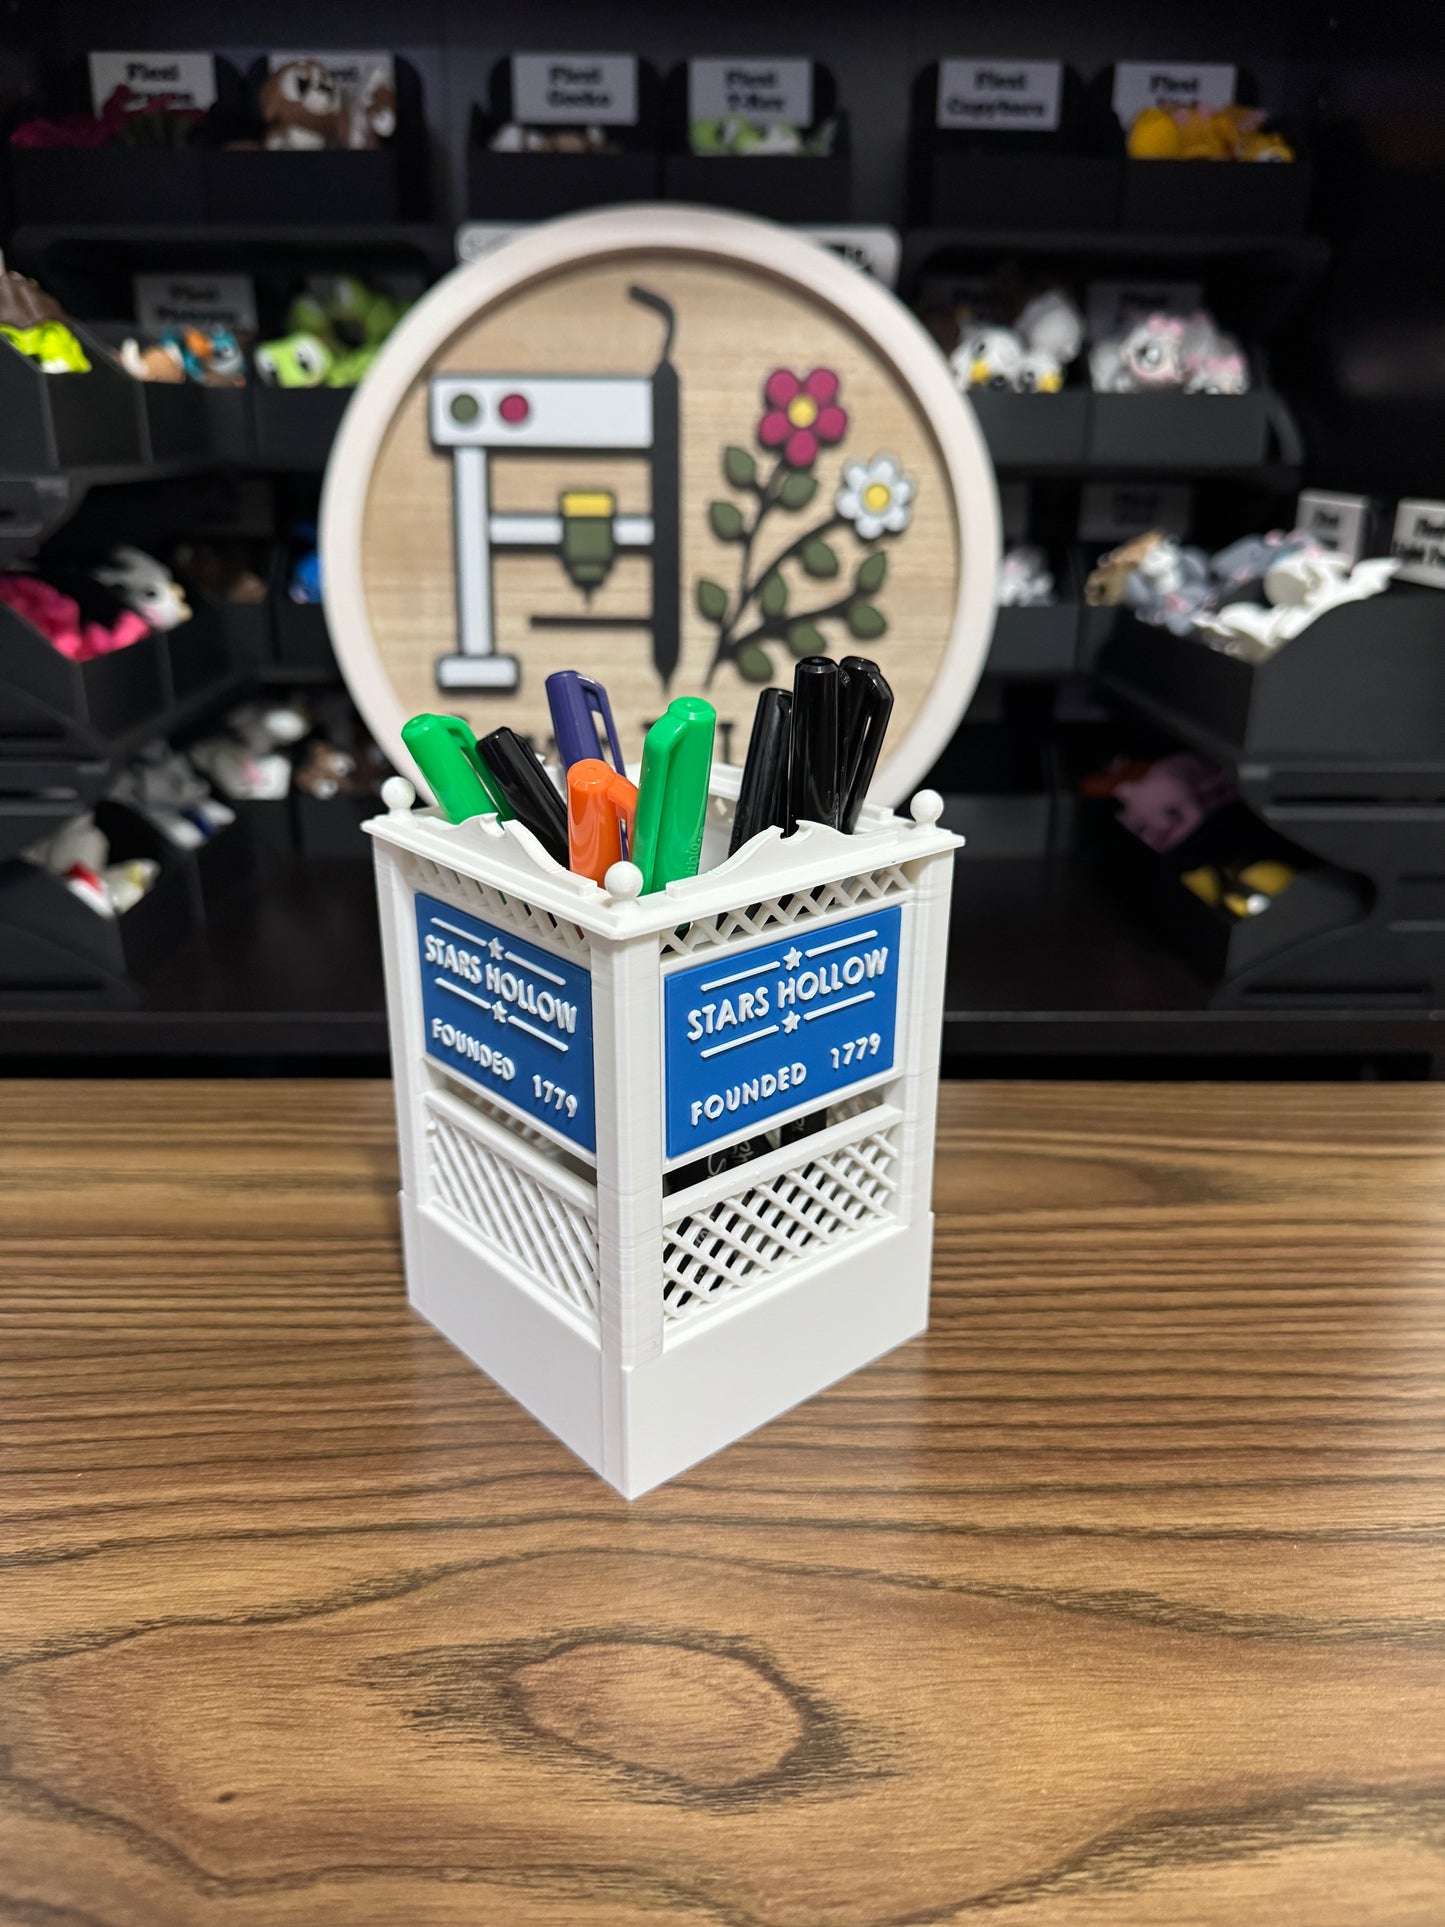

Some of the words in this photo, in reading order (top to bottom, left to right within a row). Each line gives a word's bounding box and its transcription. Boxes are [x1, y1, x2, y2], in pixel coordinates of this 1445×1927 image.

[425, 934, 482, 985] STARS
[485, 963, 578, 1034] HOLLOW
[687, 986, 770, 1041] STARS
[777, 946, 889, 1009] HOLLOW
[431, 1017, 516, 1081] FOUNDED
[532, 1074, 579, 1118] 1779
[691, 1062, 807, 1126] FOUNDED
[830, 1032, 881, 1069] 1779
